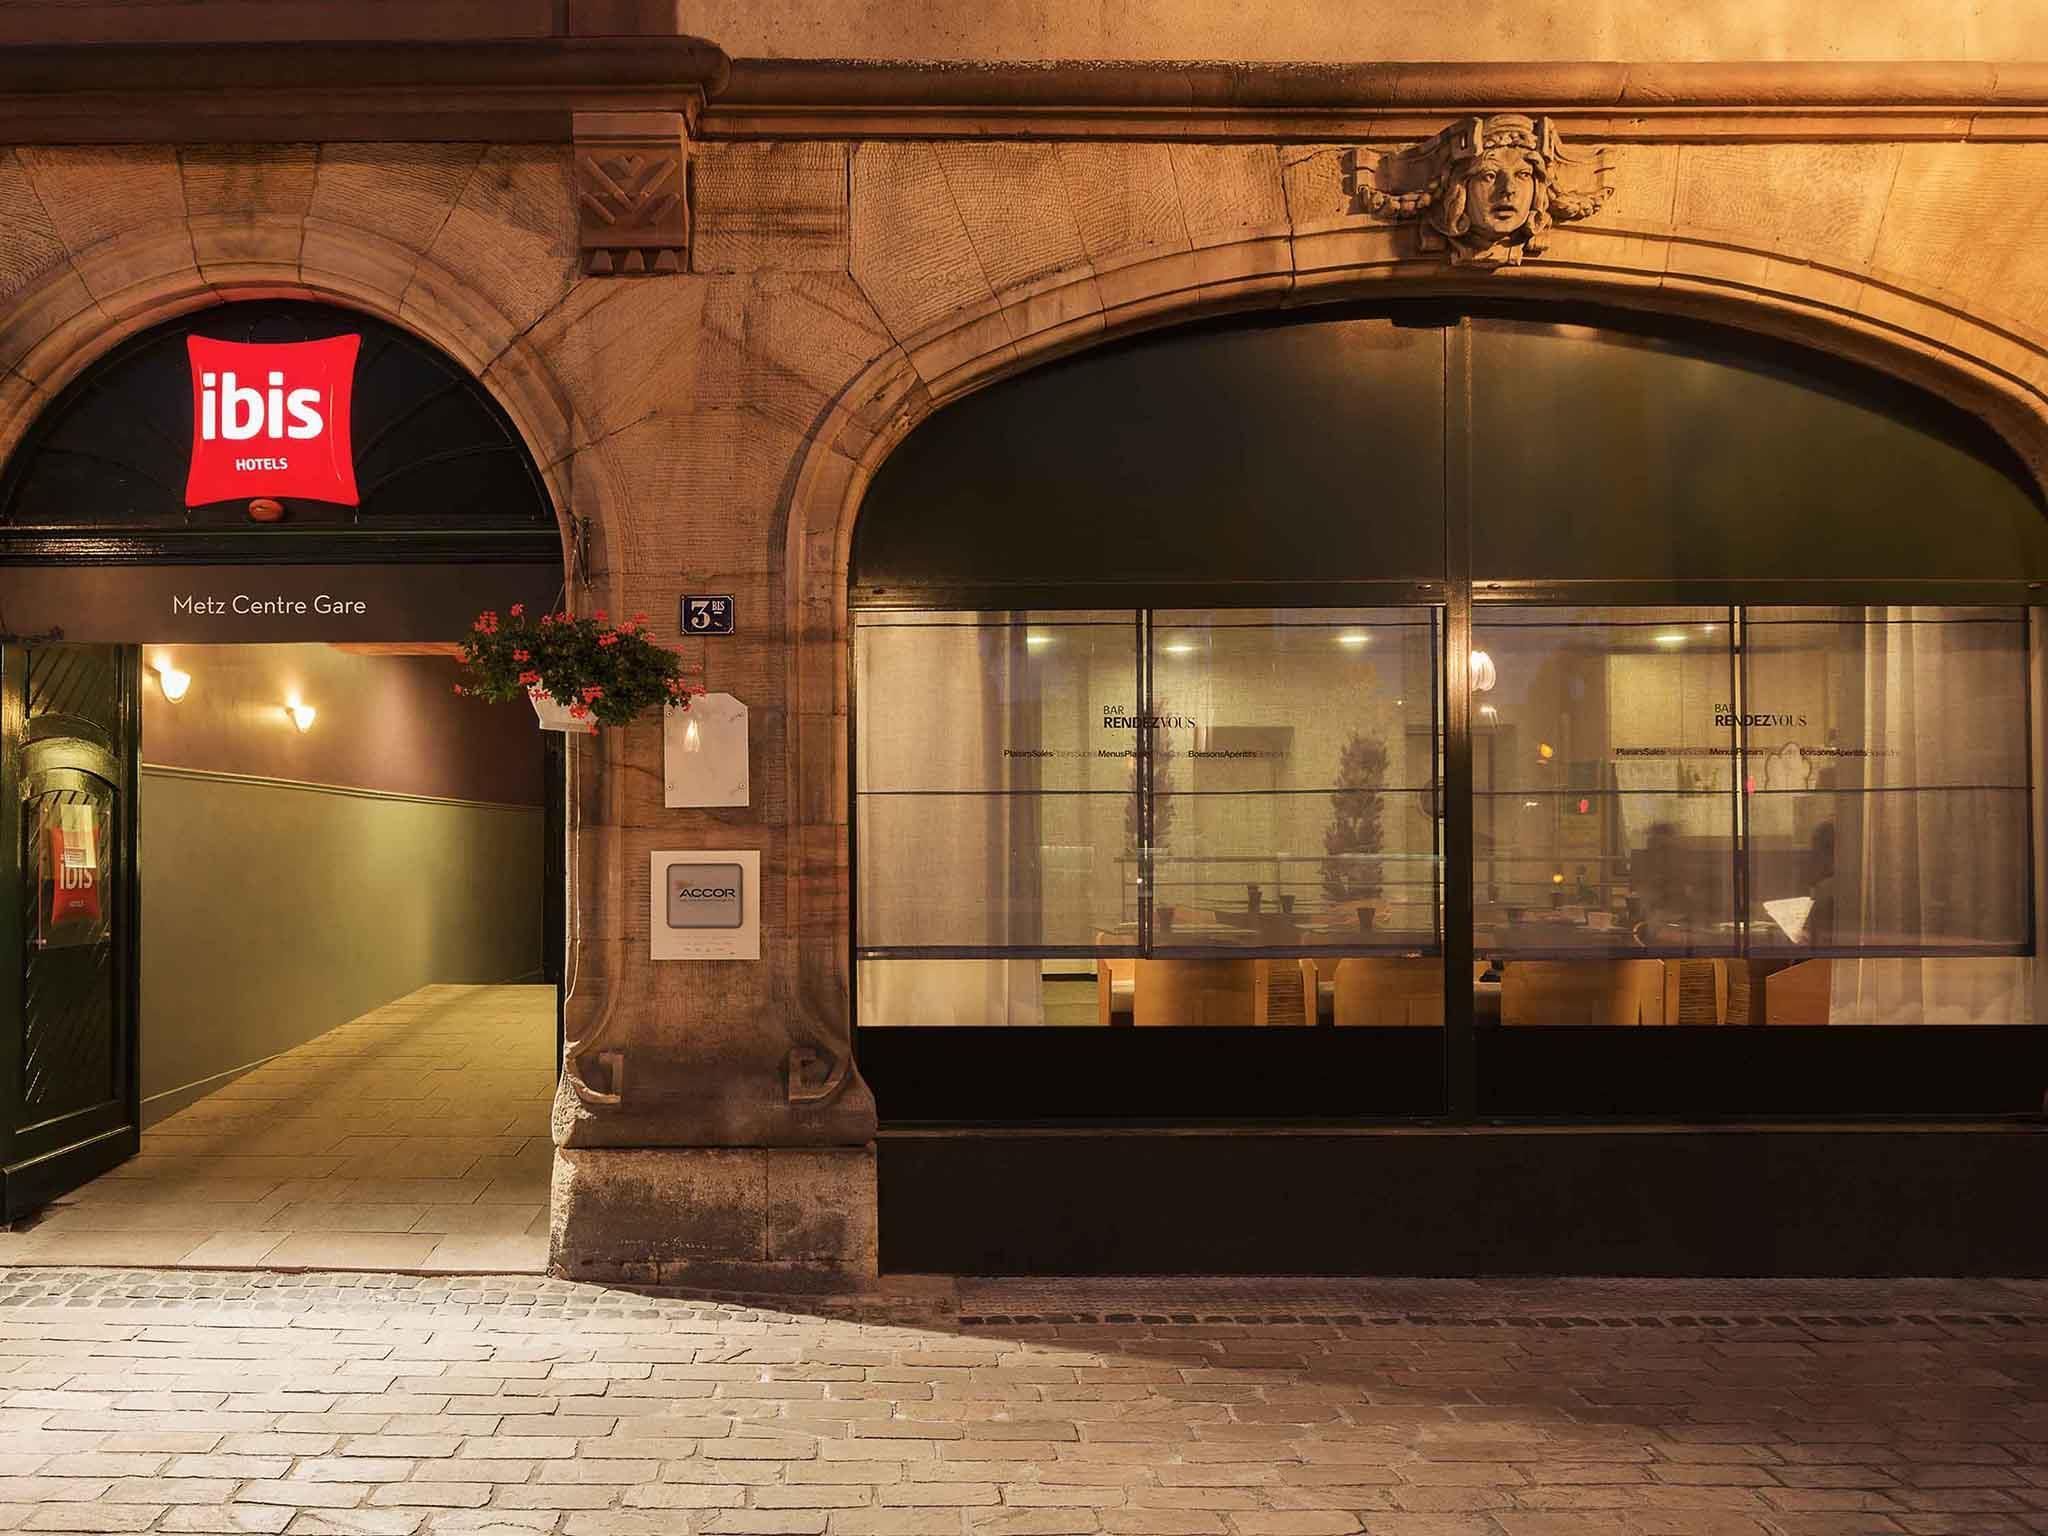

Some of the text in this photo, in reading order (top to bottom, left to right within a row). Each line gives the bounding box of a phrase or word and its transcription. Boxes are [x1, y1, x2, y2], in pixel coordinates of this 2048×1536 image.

[202, 371, 324, 440] ibis
[235, 457, 289, 471] HOTELS
[173, 595, 367, 614] Metz Centre Gare
[691, 600, 725, 628] 3 BIS
[1103, 705, 1125, 715] BAR
[679, 887, 737, 899] ACCOR
